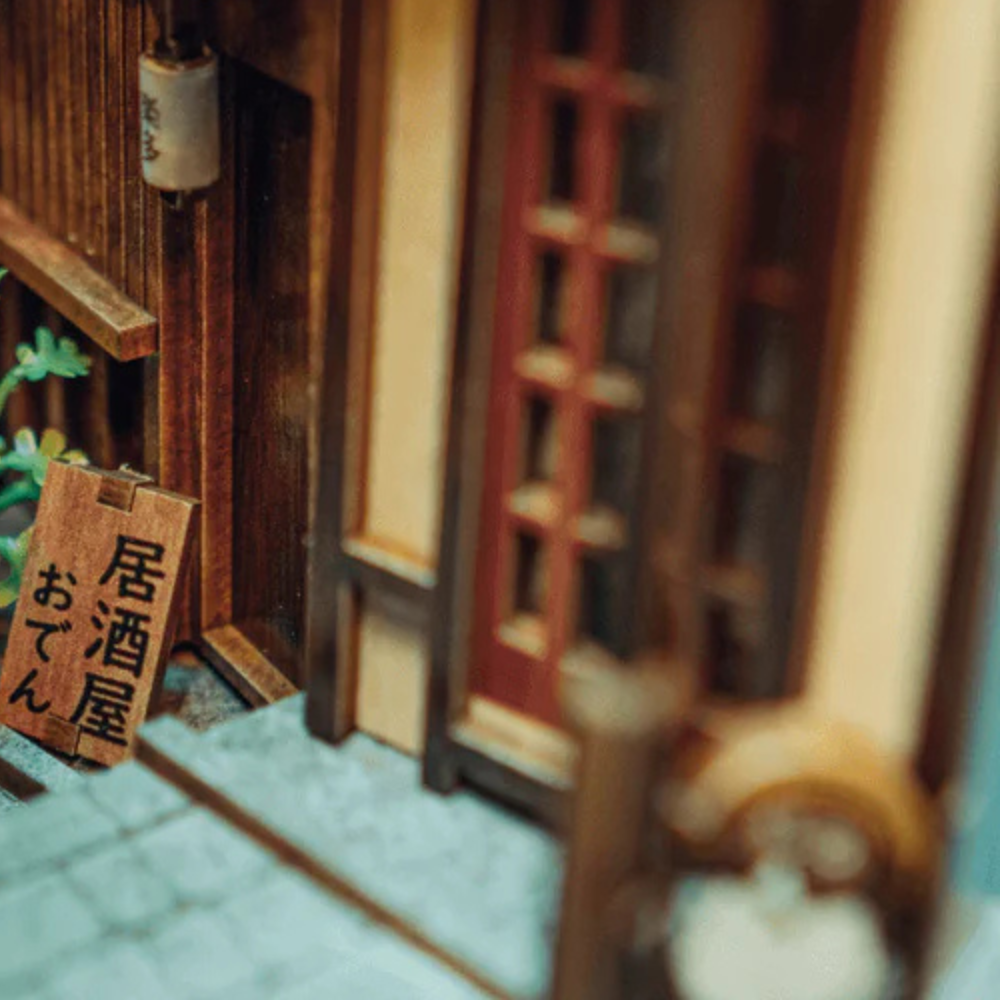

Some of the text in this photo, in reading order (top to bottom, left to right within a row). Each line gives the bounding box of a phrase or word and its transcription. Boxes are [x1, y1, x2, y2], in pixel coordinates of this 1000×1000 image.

[8, 563, 77, 714] おでん
[71, 535, 165, 746] 居酒屋
